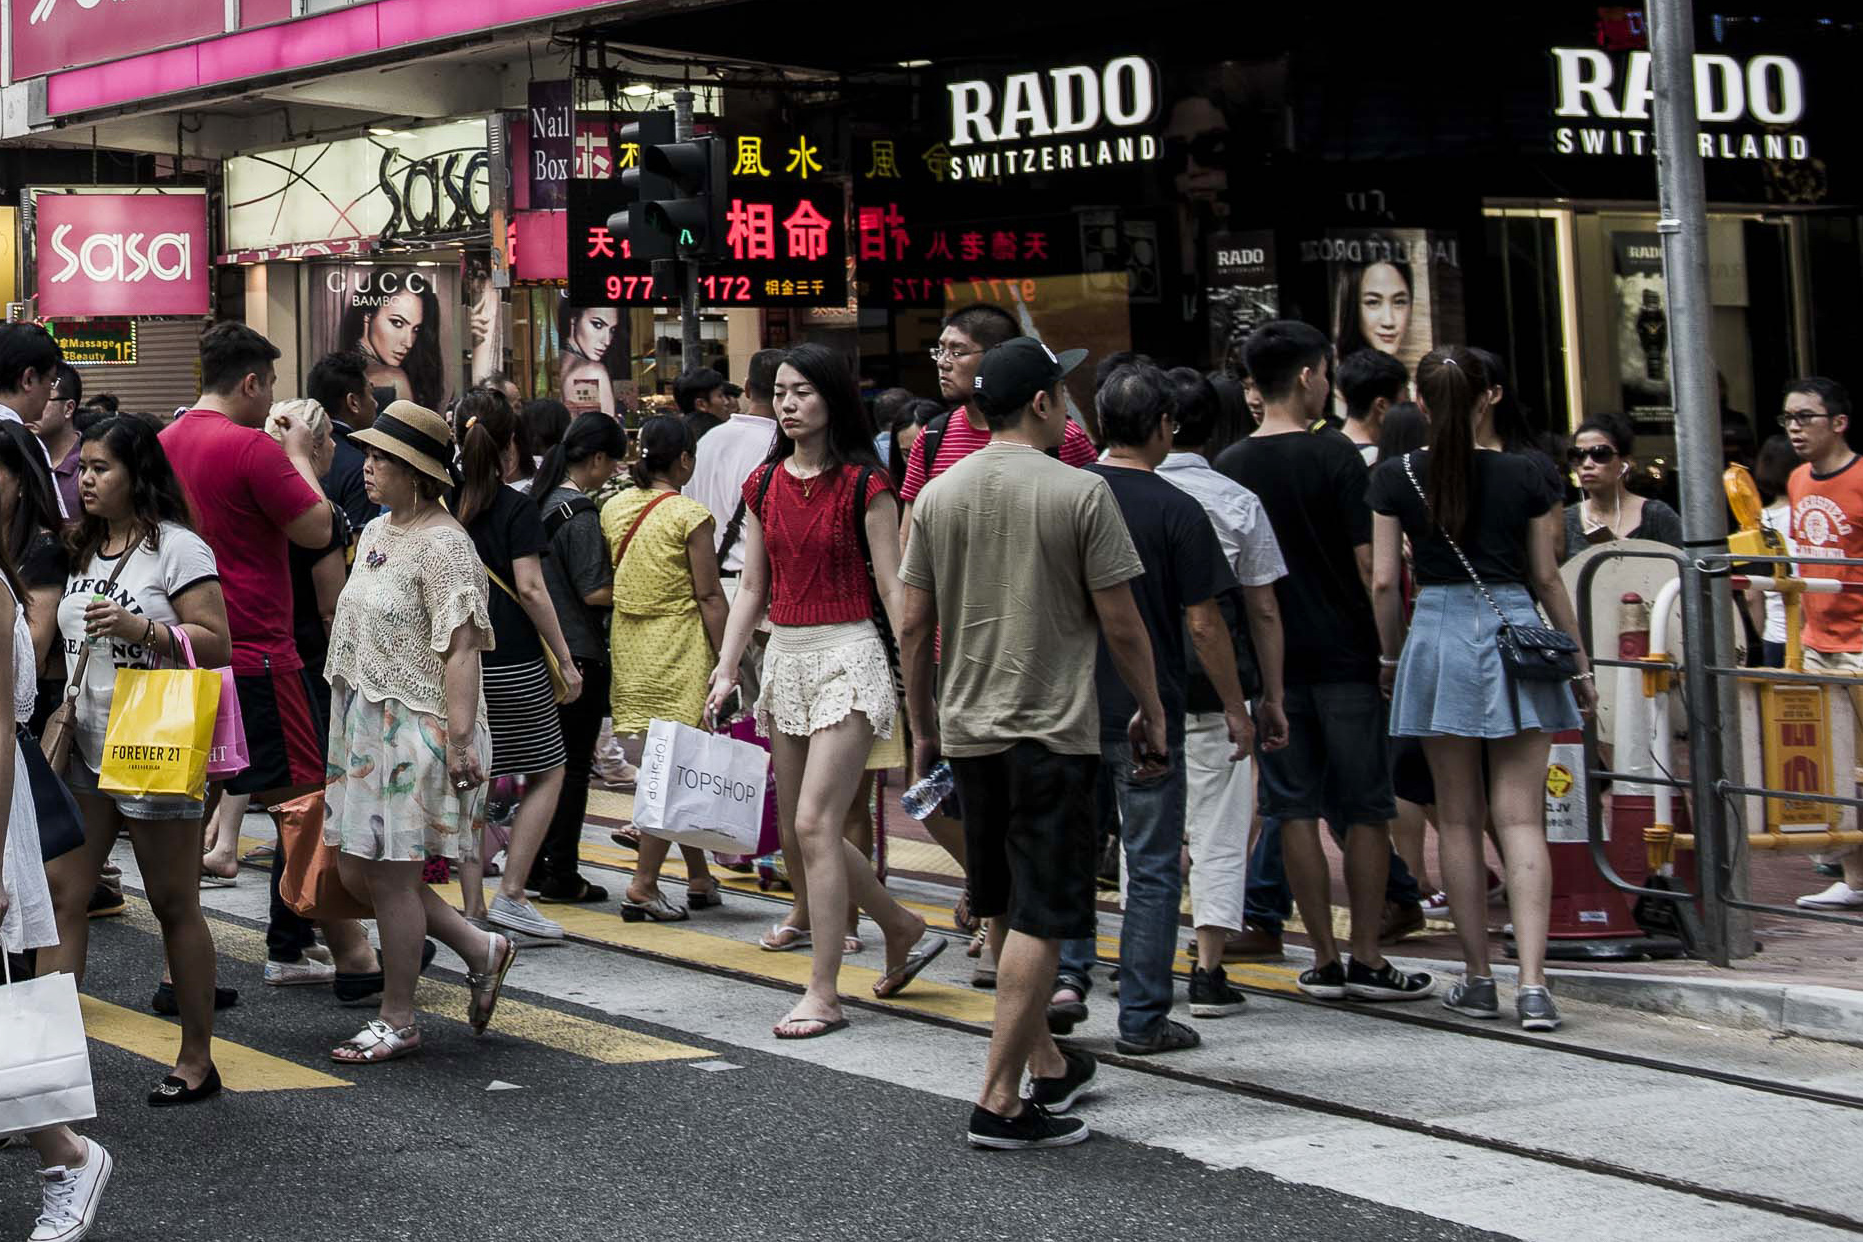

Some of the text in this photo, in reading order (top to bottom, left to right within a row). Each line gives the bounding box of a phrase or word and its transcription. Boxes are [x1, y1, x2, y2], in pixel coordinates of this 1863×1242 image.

[947, 56, 1155, 147] RADO
[533, 107, 570, 138] Nail
[950, 135, 1157, 181] SWITZERLAND
[1557, 128, 1808, 159] SWITRLAND
[535, 151, 568, 181] Box
[726, 199, 832, 261] 相命
[1217, 248, 1265, 268] RADO
[326, 271, 437, 294] GUCCI
[607, 276, 751, 300] 977 172
[69, 339, 115, 349] Massage
[69, 352, 105, 361] Beauty
[115, 342, 132, 360] 1F
[112, 745, 181, 763] FOREVER 21
[648, 735, 669, 800] TOPSHOP
[676, 765, 756, 804] TOPSHOP
